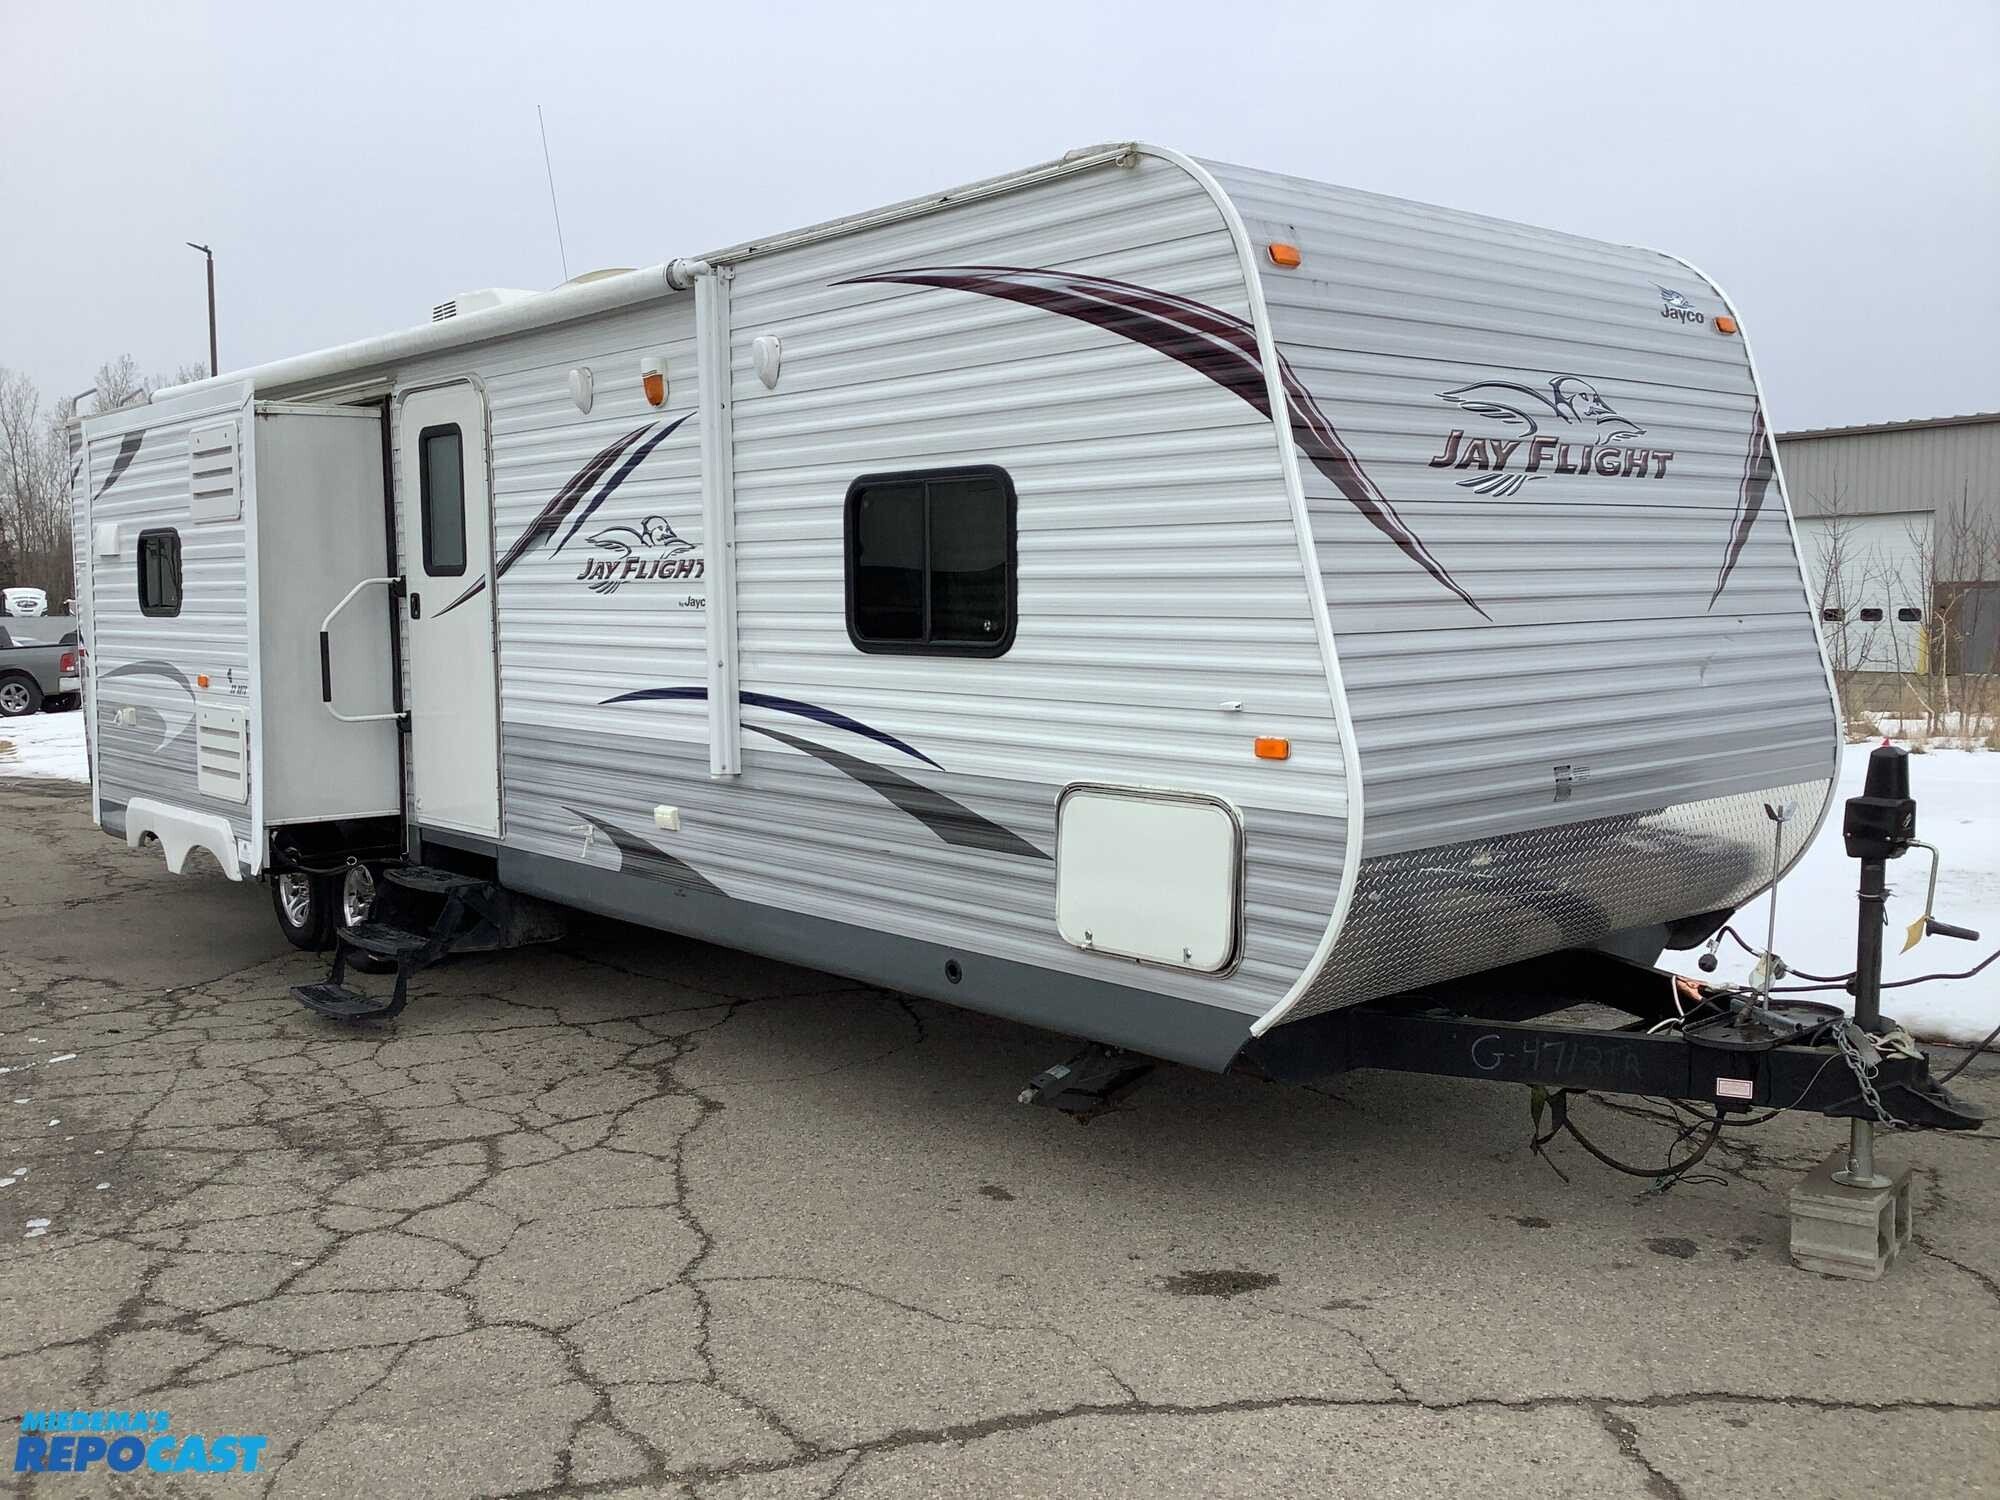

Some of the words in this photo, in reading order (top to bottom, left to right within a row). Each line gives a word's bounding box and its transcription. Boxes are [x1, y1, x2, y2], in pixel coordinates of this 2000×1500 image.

[1661, 303, 1704, 324] Jayco
[1428, 429, 1519, 471] JAY
[1525, 436, 1674, 479] FLIGHT
[576, 558, 621, 580] JAY
[684, 595, 706, 609] Jayc
